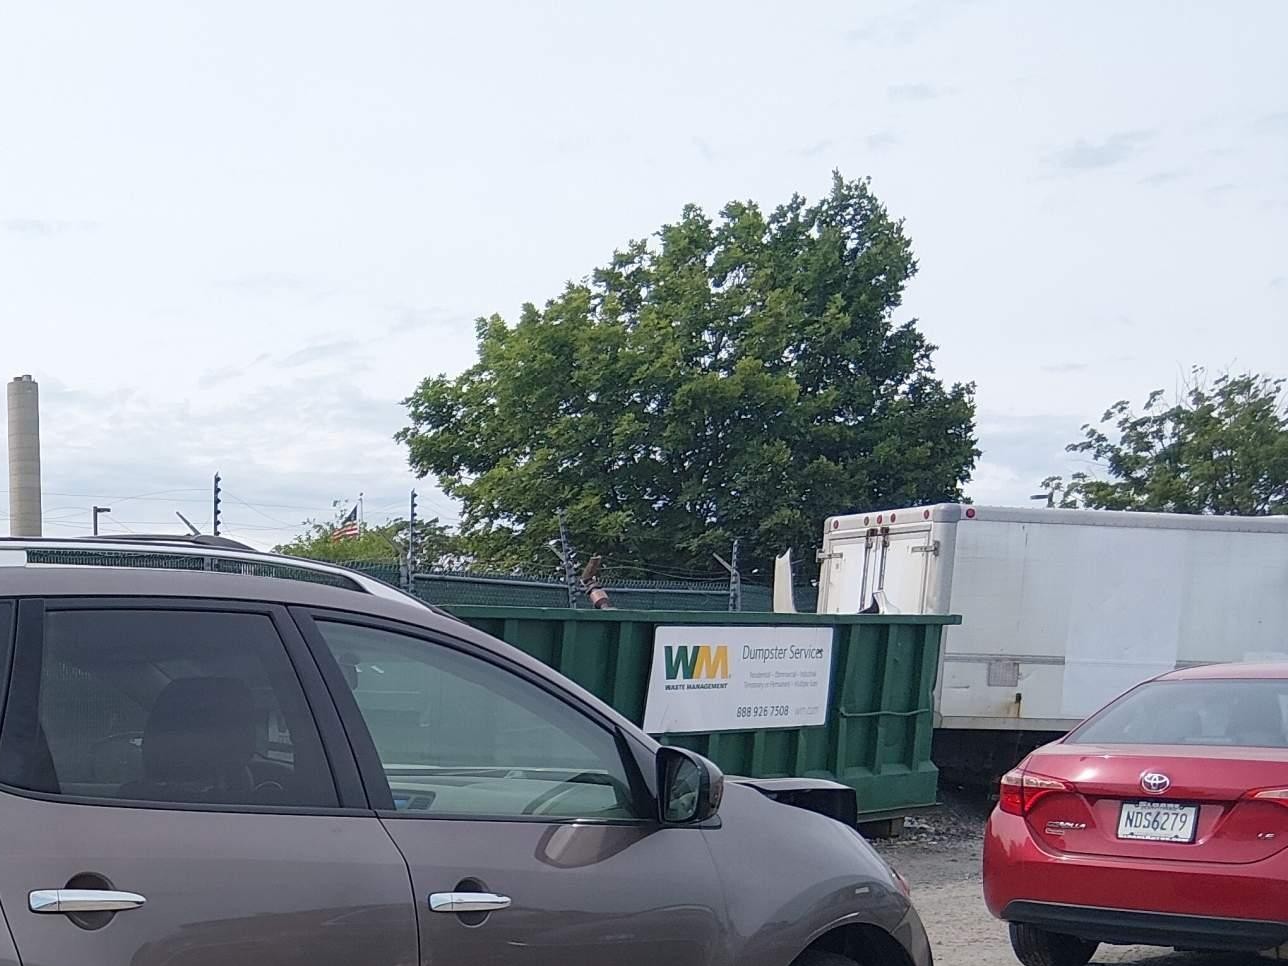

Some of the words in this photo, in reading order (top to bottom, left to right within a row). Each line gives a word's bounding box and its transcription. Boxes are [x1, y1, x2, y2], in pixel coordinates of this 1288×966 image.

[664, 645, 729, 680] WM
[742, 644, 788, 663] Dumpster
[789, 644, 824, 660] Services
[686, 682, 729, 690] MANAGEMENT
[736, 705, 752, 718] 888
[753, 705, 768, 717] 926
[769, 704, 789, 717] 7508
[1124, 811, 1188, 831] NDS6279
